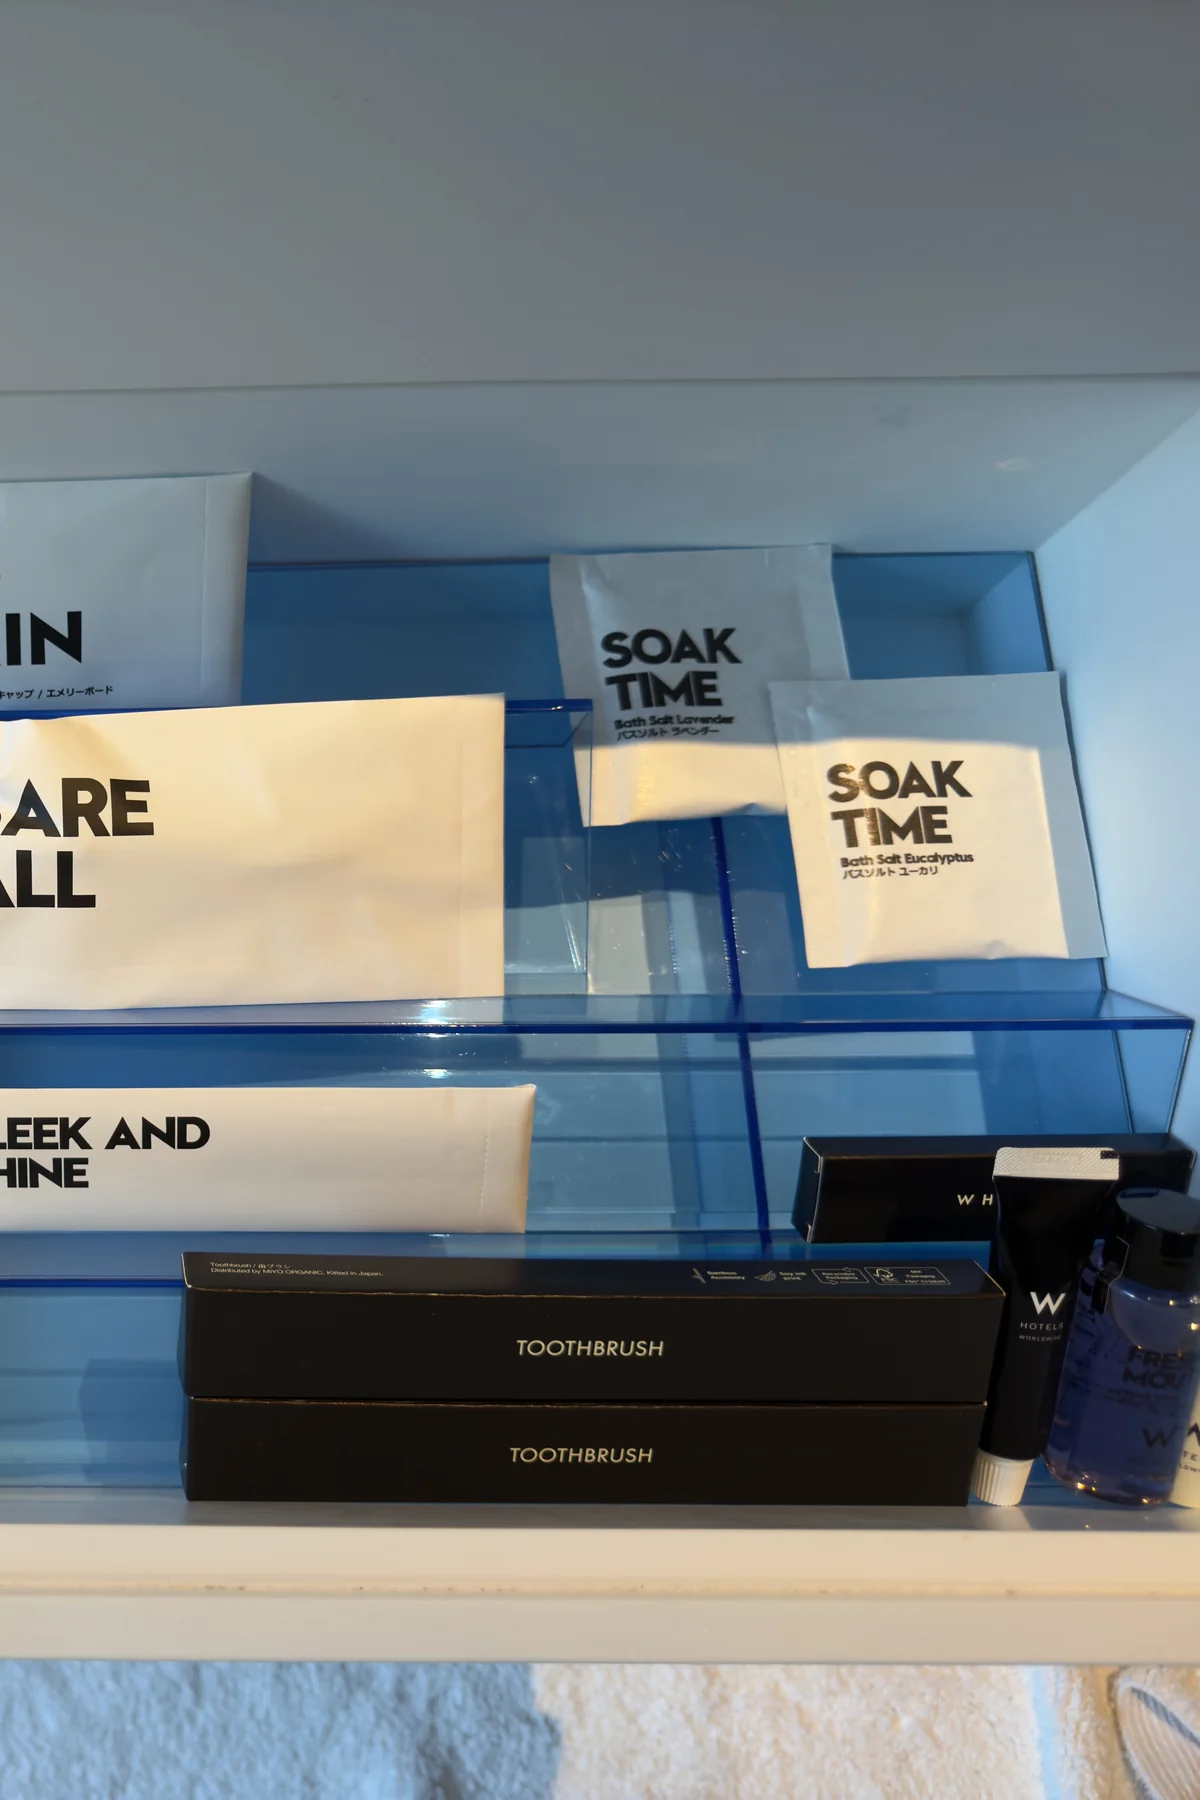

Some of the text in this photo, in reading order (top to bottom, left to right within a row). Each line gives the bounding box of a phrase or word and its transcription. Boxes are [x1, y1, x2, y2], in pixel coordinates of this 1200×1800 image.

[601, 628, 743, 668] SOAK
[46, 686, 114, 698] エメリーボード
[604, 671, 723, 711] TIME
[614, 713, 735, 730] Bath Salt Lavender
[616, 725, 720, 741] バスソルト ラベンダー
[826, 760, 973, 803] SOAK
[830, 805, 953, 848] TIME
[840, 852, 975, 868] Bath Salt Eucalyptus
[842, 865, 939, 880] バスソルト ユーカリ
[104, 1116, 211, 1150] AND
[1030, 1291, 1066, 1316] W
[1019, 1320, 1065, 1331] HOTELS
[516, 1339, 664, 1357] TOOTHBRUSH
[509, 1447, 654, 1464] TOOTHBRUSH
